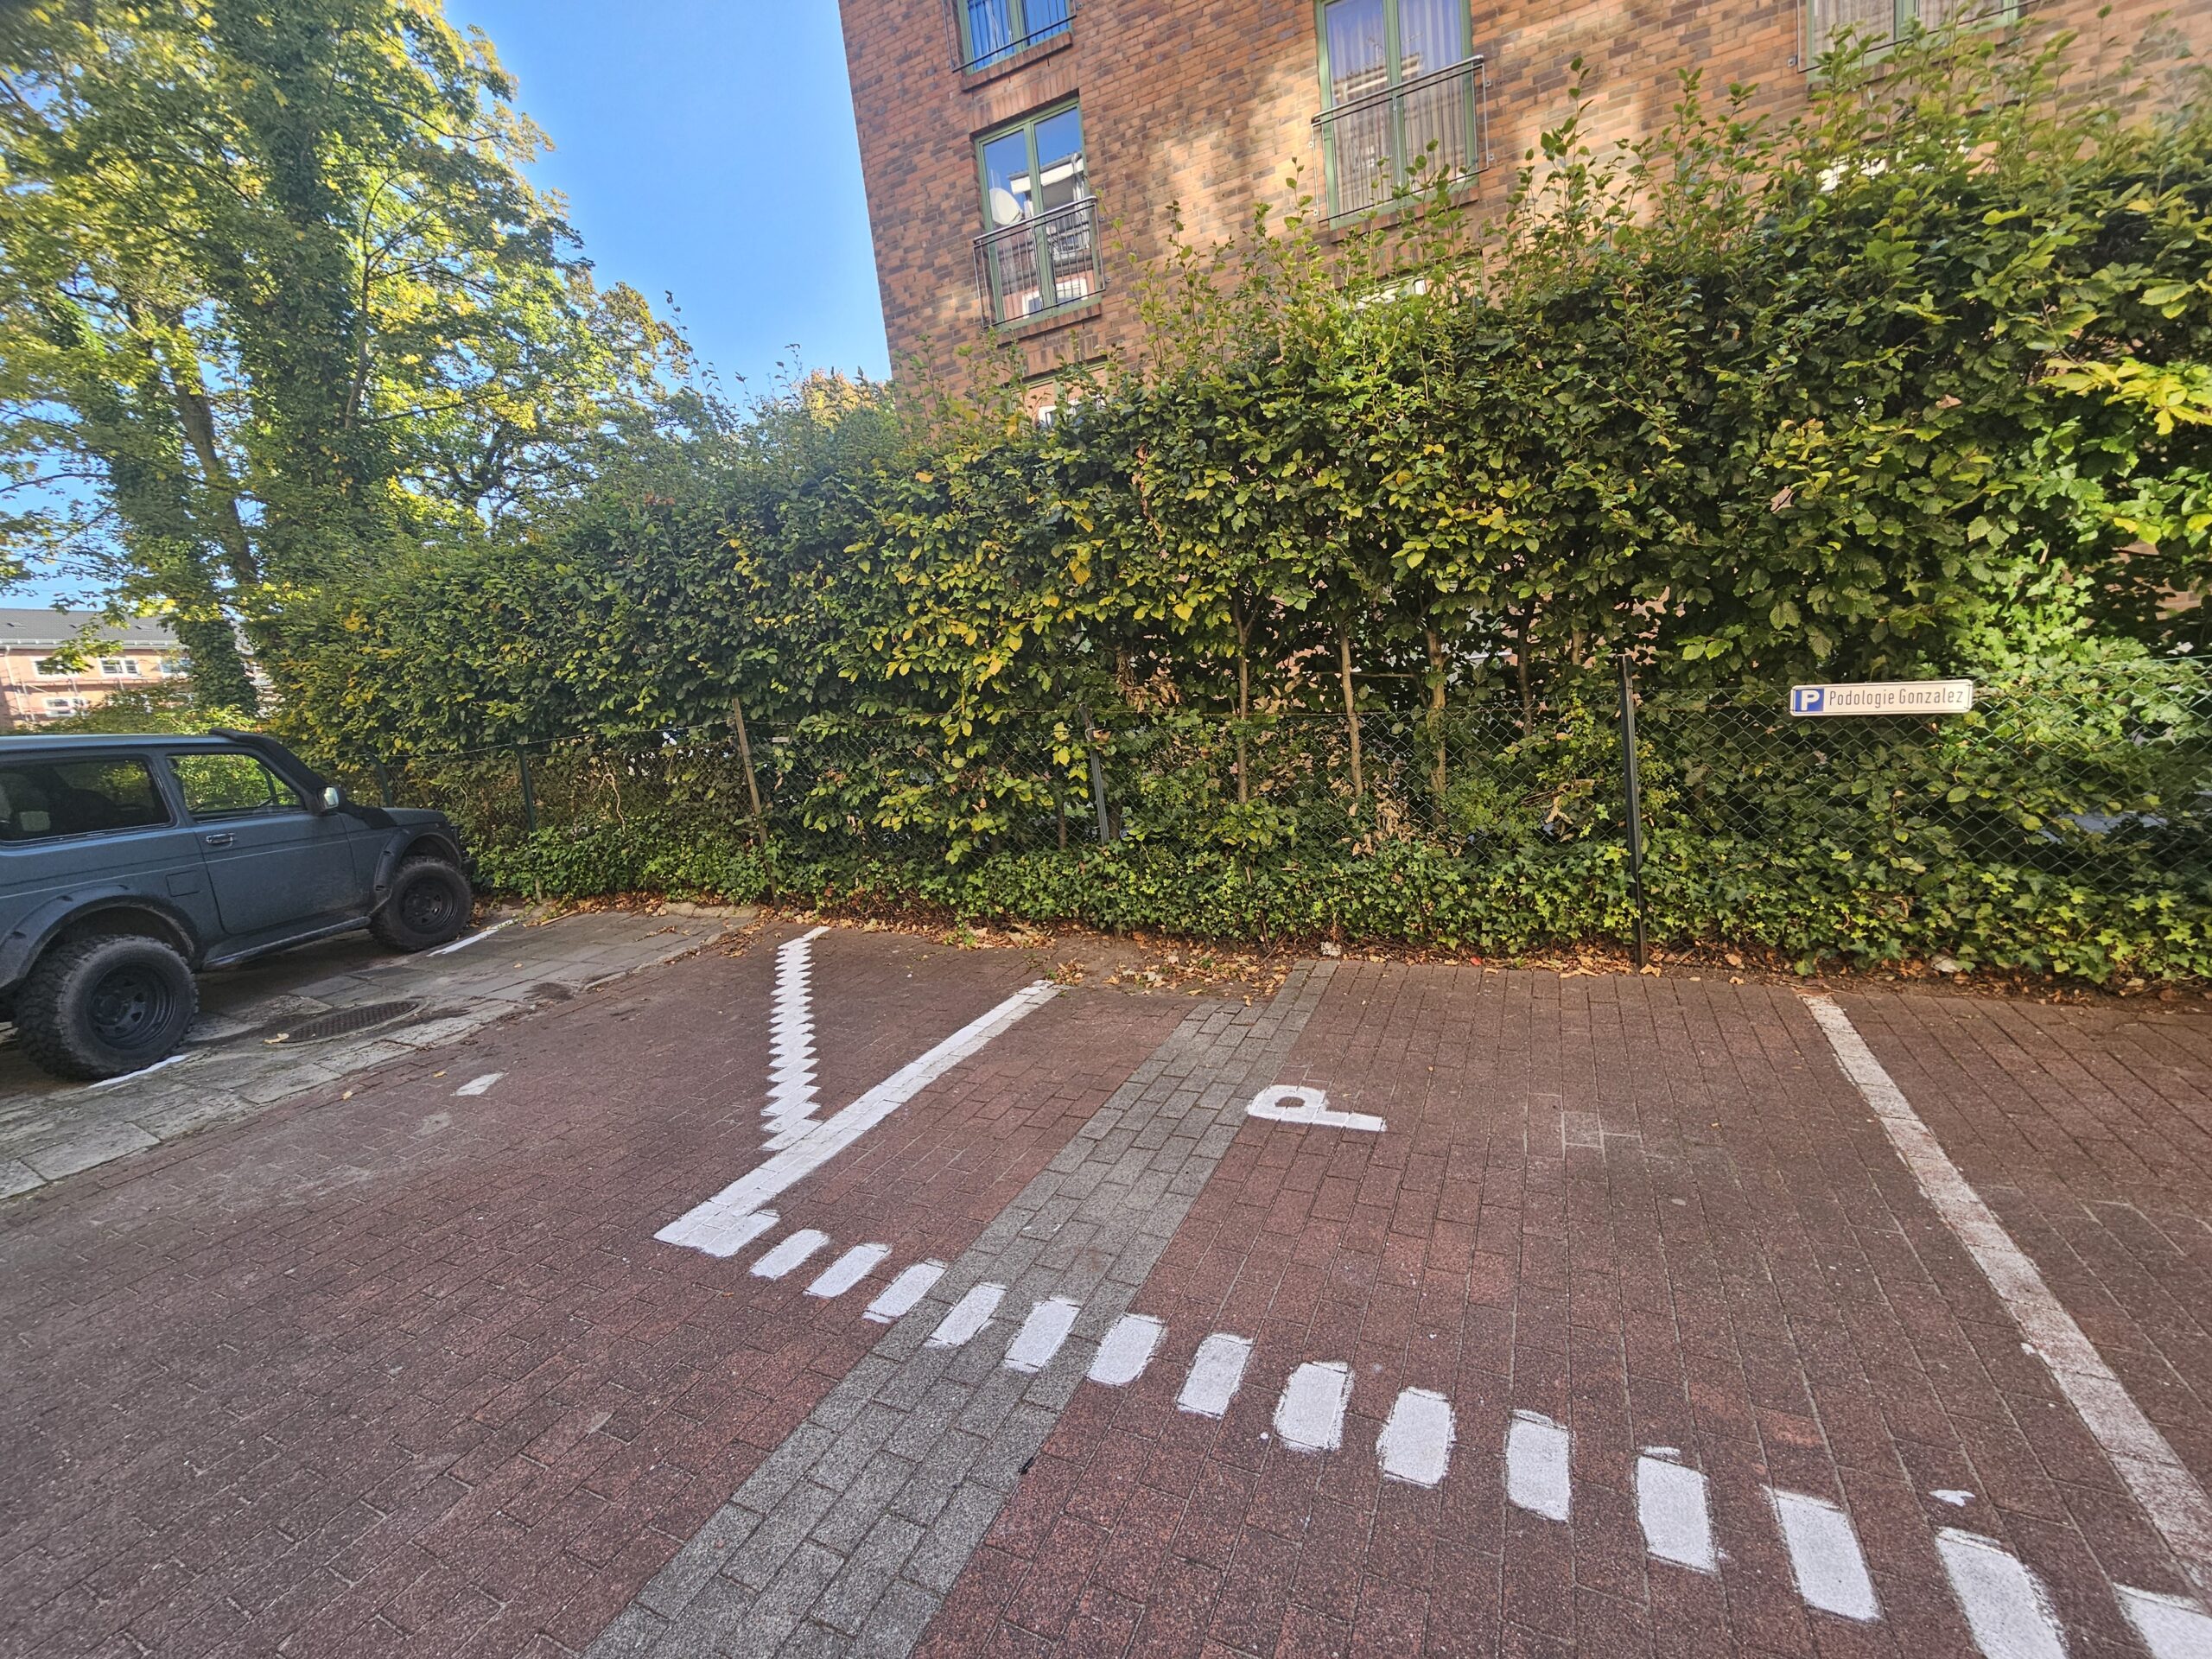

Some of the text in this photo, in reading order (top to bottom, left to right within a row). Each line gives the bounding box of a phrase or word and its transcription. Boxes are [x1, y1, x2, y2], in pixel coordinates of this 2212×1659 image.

[1801, 688, 1963, 711] P Podologie Gonzalez
